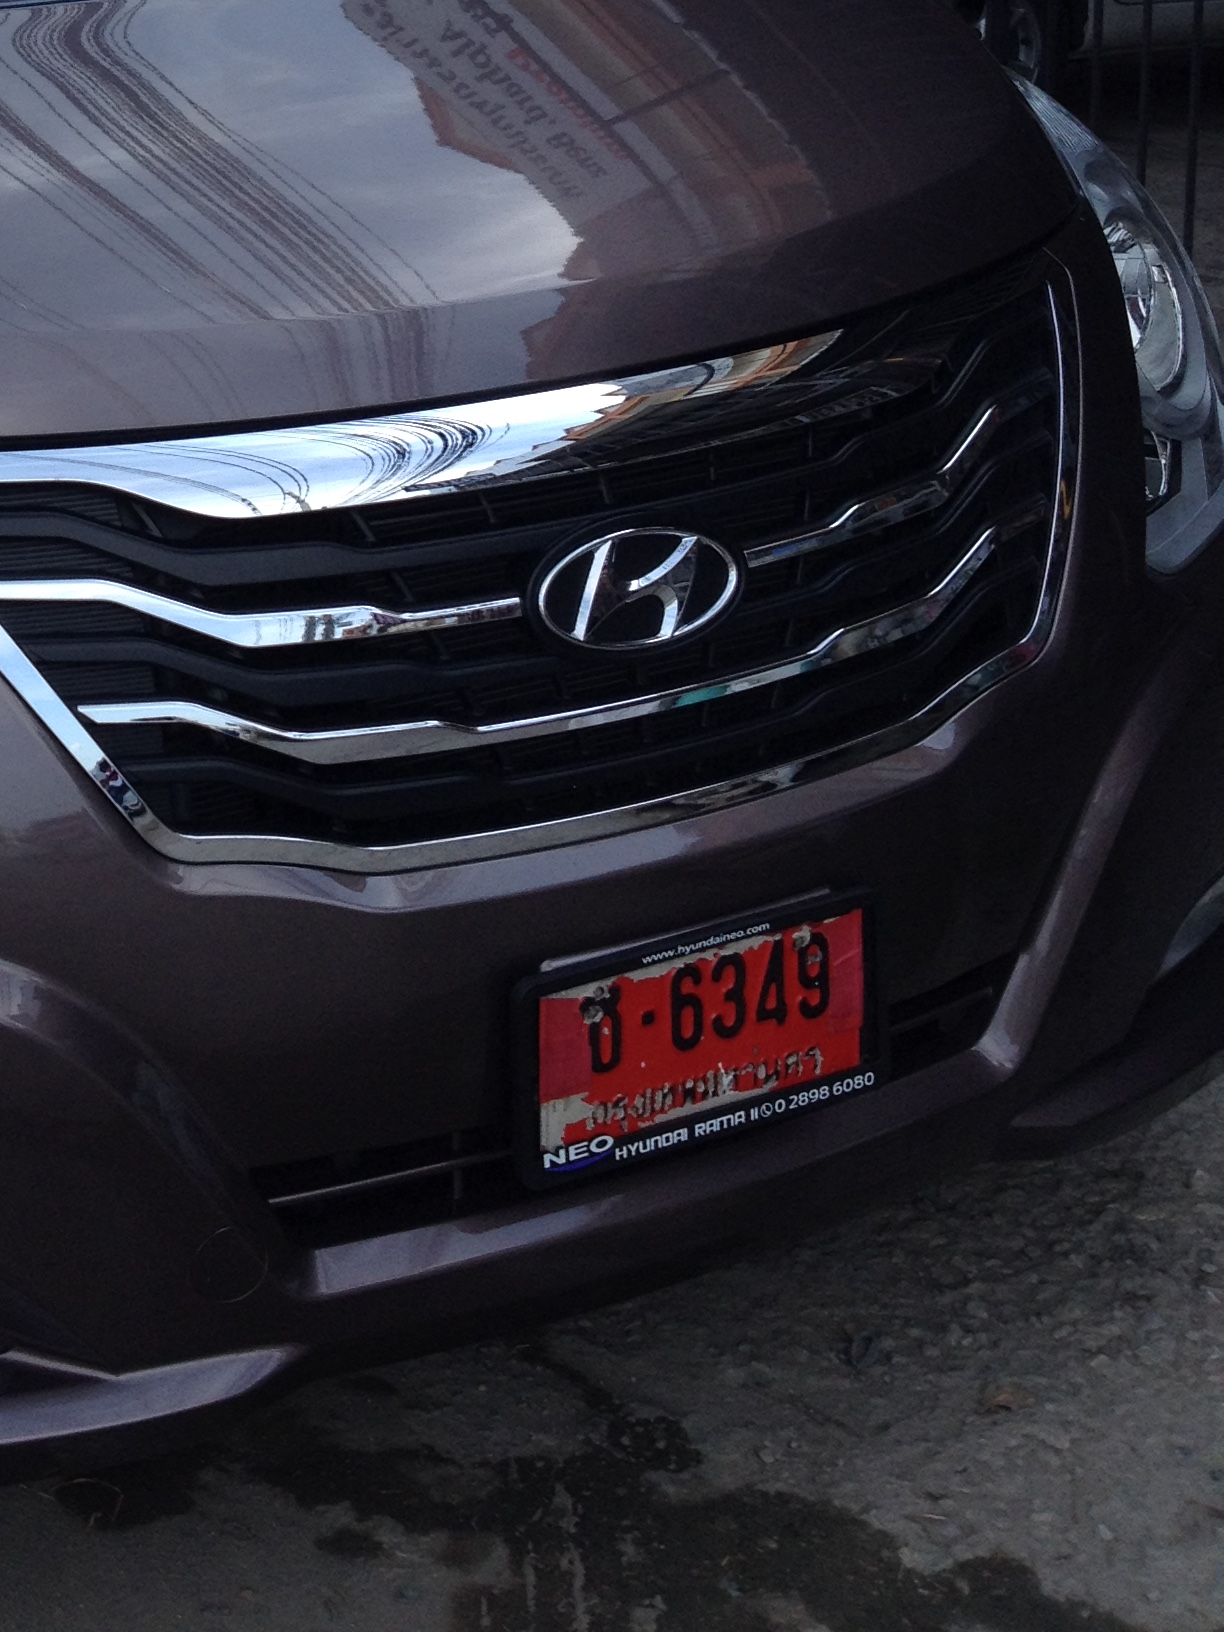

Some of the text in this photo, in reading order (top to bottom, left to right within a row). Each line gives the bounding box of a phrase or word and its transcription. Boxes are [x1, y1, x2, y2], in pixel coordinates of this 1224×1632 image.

[641, 921, 771, 964] www.hyundaineo.com
[671, 931, 831, 1052] 6349
[542, 1134, 615, 1169] NEO
[614, 1127, 689, 1161] HYUNDAI
[693, 1110, 746, 1136] RAMA
[788, 1084, 830, 1110] 2898
[832, 1070, 876, 1097] 6080
